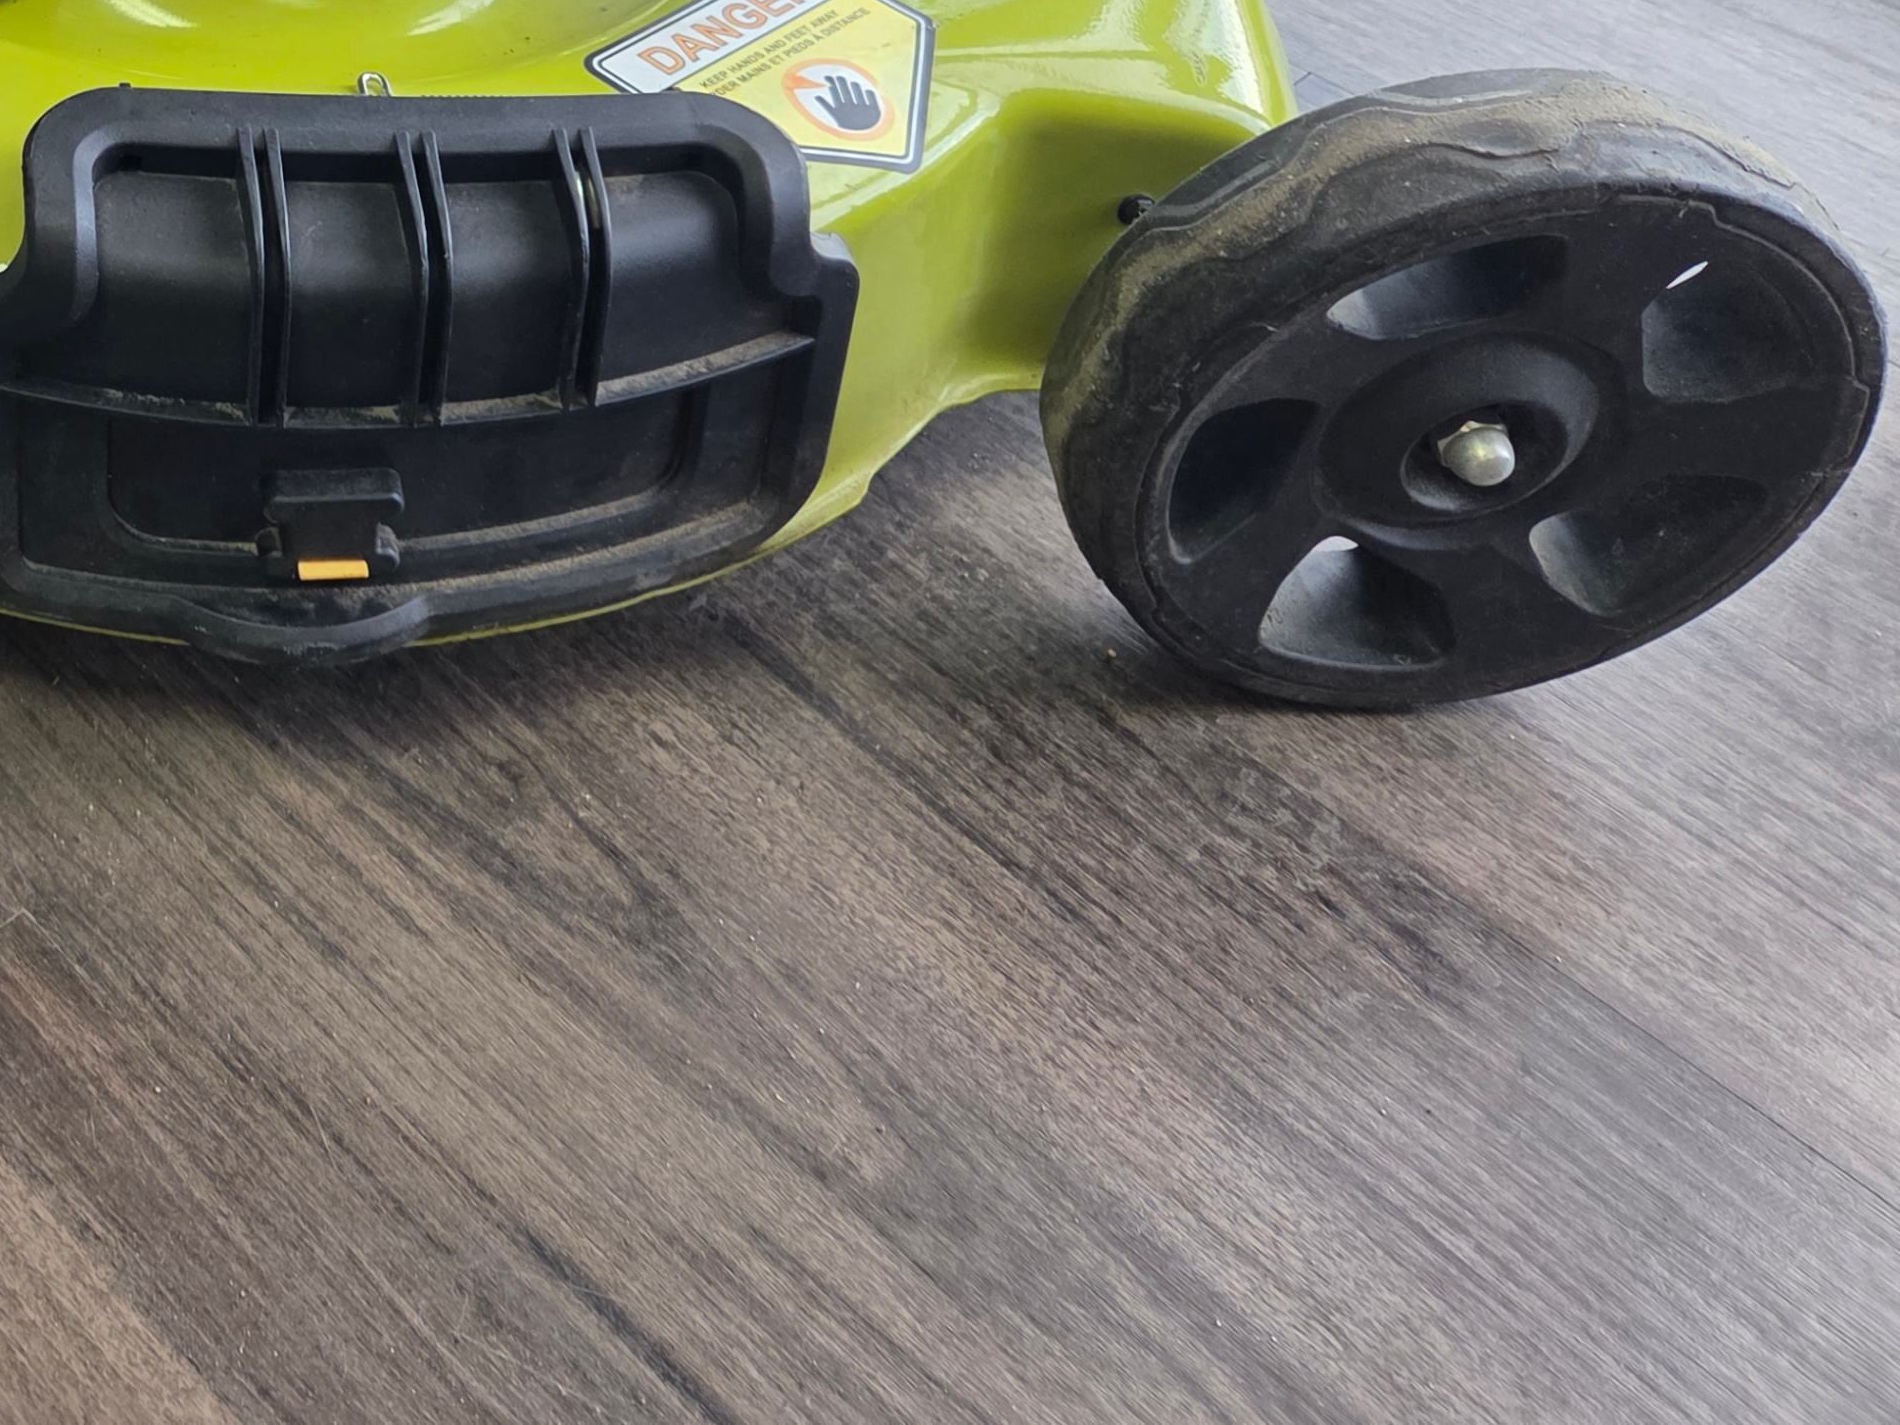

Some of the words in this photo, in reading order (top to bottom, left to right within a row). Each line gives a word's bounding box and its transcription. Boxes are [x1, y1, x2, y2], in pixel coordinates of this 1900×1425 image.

[700, 71, 727, 89] KEEP
[727, 52, 765, 74] HANDS
[763, 39, 786, 54] AND
[784, 25, 811, 43] FEET
[809, 9, 838, 29] AWAY
[741, 63, 772, 83] MAINS
[772, 54, 785, 66] ET
[786, 39, 814, 58] PIEDS
[821, 7, 871, 36] DISTANCE
